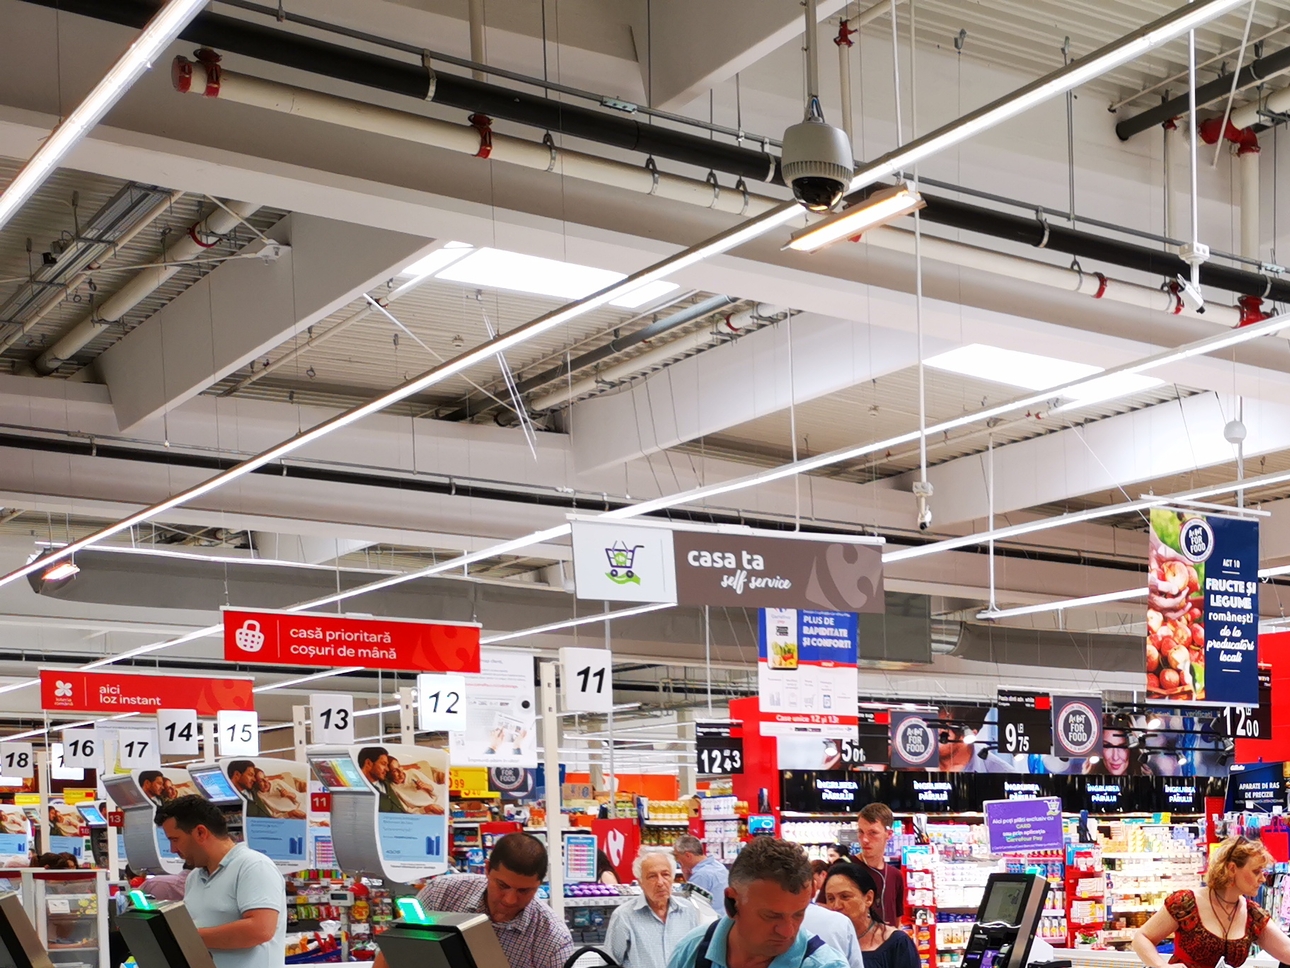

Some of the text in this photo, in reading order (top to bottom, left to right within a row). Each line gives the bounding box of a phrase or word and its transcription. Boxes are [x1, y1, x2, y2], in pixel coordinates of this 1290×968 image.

[1190, 543, 1206, 553] FOOD
[1191, 536, 1202, 545] FOR
[688, 550, 764, 570] casa ta
[1222, 559, 1230, 567] ACT
[721, 570, 792, 594] self service
[1206, 578, 1256, 595] FRUCTE ȘI
[1210, 594, 1252, 609] LEGUME
[803, 615, 835, 626] PLUS DE
[1208, 612, 1253, 625] românești
[290, 627, 391, 643] casă prioritară
[802, 626, 848, 637] RAPIDITATE
[1233, 626, 1241, 637] la
[290, 643, 397, 660] coșuri de mână
[1219, 651, 1242, 662] locali
[577, 666, 605, 693] 11
[99, 685, 120, 694] aici
[100, 694, 161, 706] loz instant
[428, 691, 460, 714] 12
[319, 708, 349, 729] 13
[1224, 706, 1246, 736] 12
[1246, 720, 1259, 737] 00
[165, 722, 193, 741] 14
[226, 724, 252, 743] 15
[1070, 723, 1084, 732] FOR
[908, 736, 922, 745] FOR
[1005, 723, 1017, 752] 9
[1018, 737, 1029, 752] 75
[1068, 733, 1087, 742] FOOD
[68, 739, 94, 757] 16
[124, 741, 149, 758] 17
[906, 744, 925, 752] FOOD
[5, 752, 29, 768] 18
[701, 749, 722, 773] 12
[313, 797, 327, 807] 11
[109, 815, 122, 823] 13
